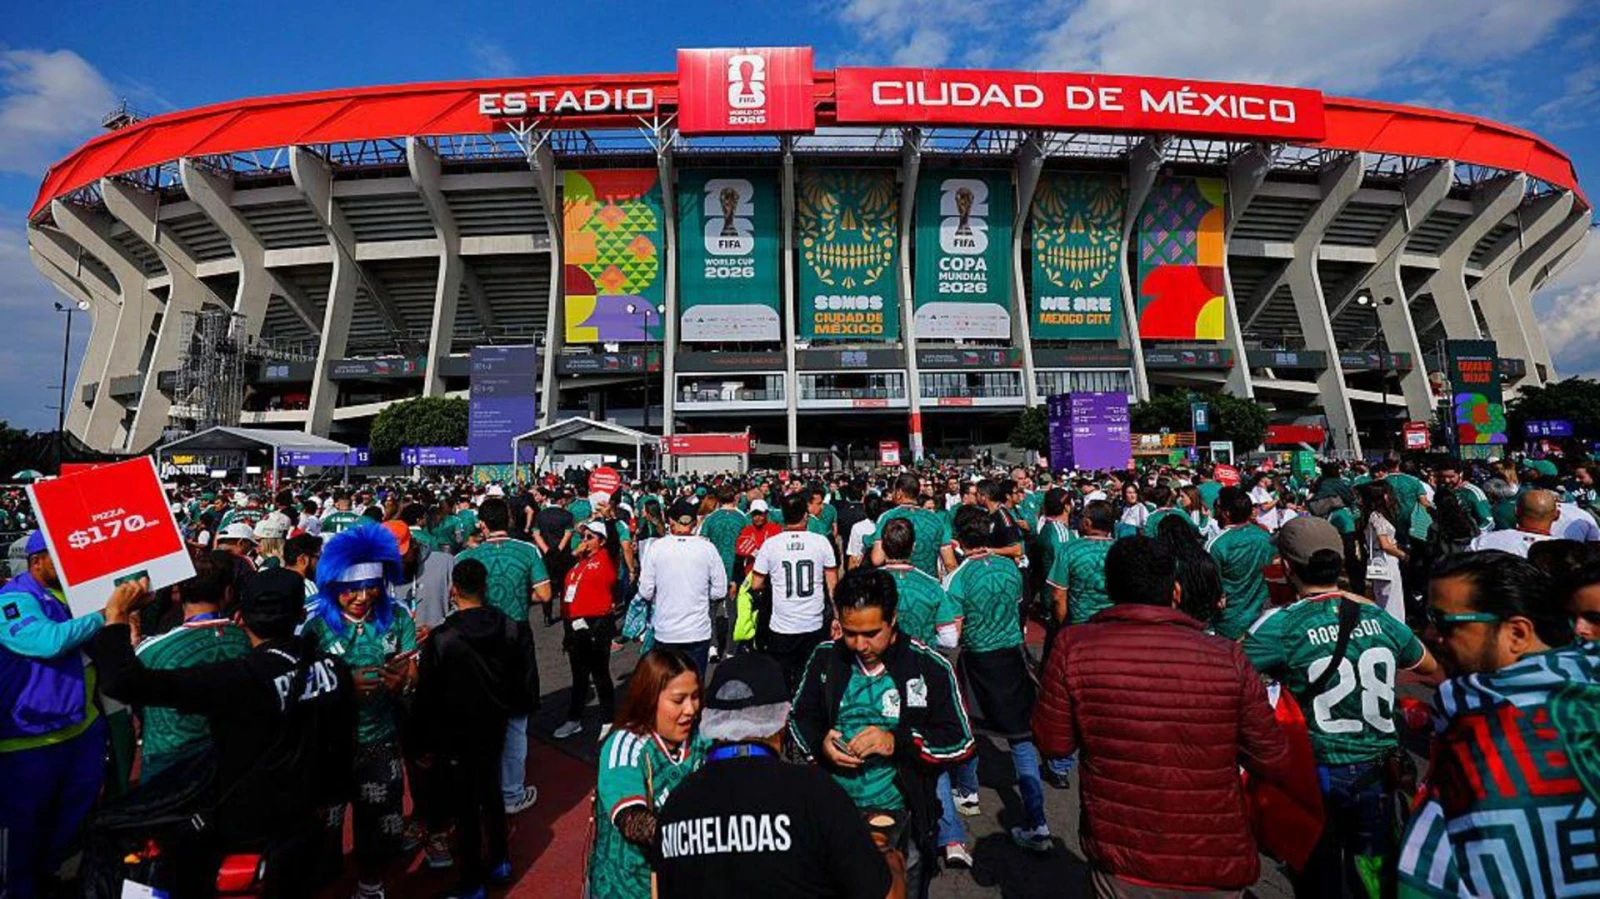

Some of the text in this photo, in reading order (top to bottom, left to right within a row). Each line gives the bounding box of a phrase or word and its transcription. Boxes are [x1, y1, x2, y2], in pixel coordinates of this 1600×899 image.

[479, 88, 654, 115] ESTADIO
[872, 80, 1297, 124] CIUDAD DE MÉXICO
[729, 116, 767, 125] 2026
[718, 240, 741, 249] FIFA
[953, 238, 976, 248] FIFA
[704, 258, 755, 266] WORLD CUP
[938, 257, 987, 271] COPA
[704, 267, 755, 278] 2026
[938, 272, 987, 281] MUNDIAL
[938, 283, 988, 294] 2026
[814, 295, 884, 311] SOMOS
[1040, 297, 1112, 312] WE ARE
[814, 312, 883, 323] CIUDAD DE
[1040, 314, 1111, 325] MEXICO CITY
[814, 322, 884, 335] MÉXICO
[91, 508, 126, 522] PIZZA
[67, 514, 146, 549] $170
[782, 559, 814, 599] 10
[1307, 618, 1383, 645] ROBSON
[1307, 646, 1396, 734] 28
[661, 813, 792, 859] MICHELADAS
